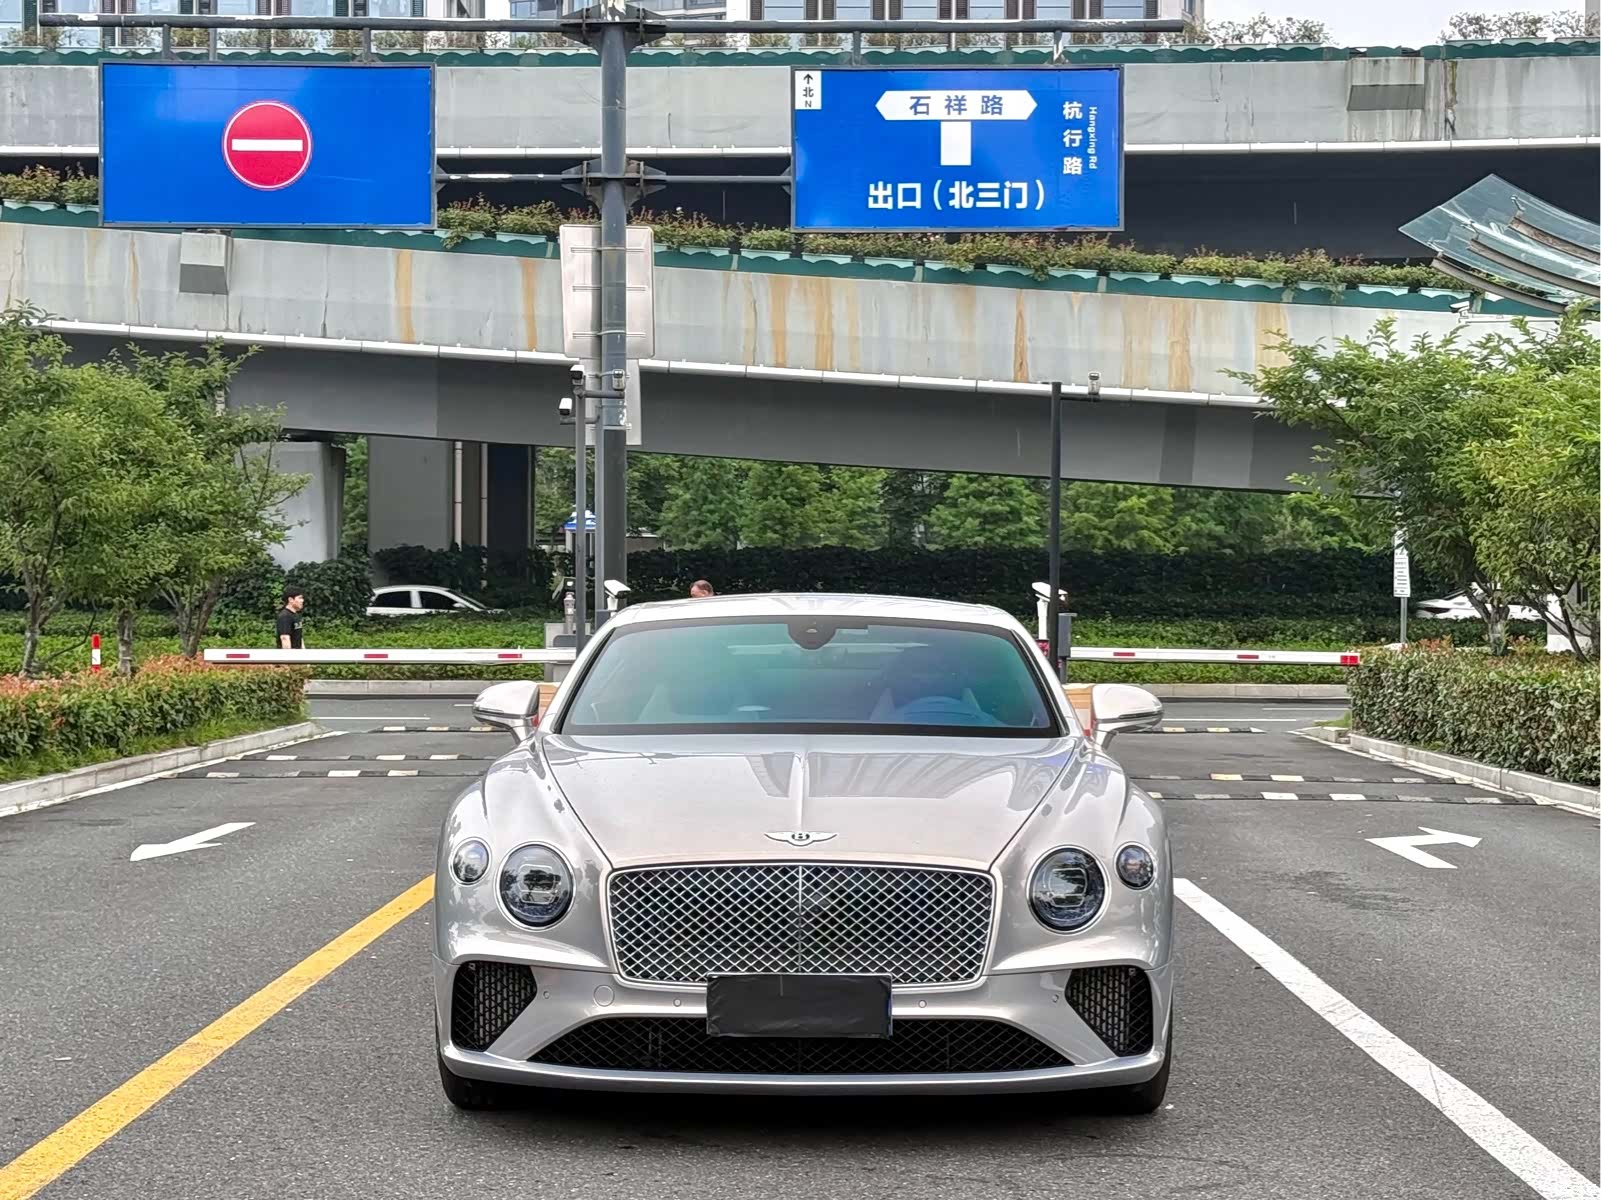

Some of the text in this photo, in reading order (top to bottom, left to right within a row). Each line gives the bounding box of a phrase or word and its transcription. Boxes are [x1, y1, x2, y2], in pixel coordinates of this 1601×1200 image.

[802, 86, 814, 98] 北
[804, 100, 812, 108] N
[909, 94, 1004, 116] 石祥路
[1062, 101, 1083, 175] 杭行路
[1087, 106, 1098, 169] Hangxing Rd
[868, 179, 1045, 210] 出口（北三门）
